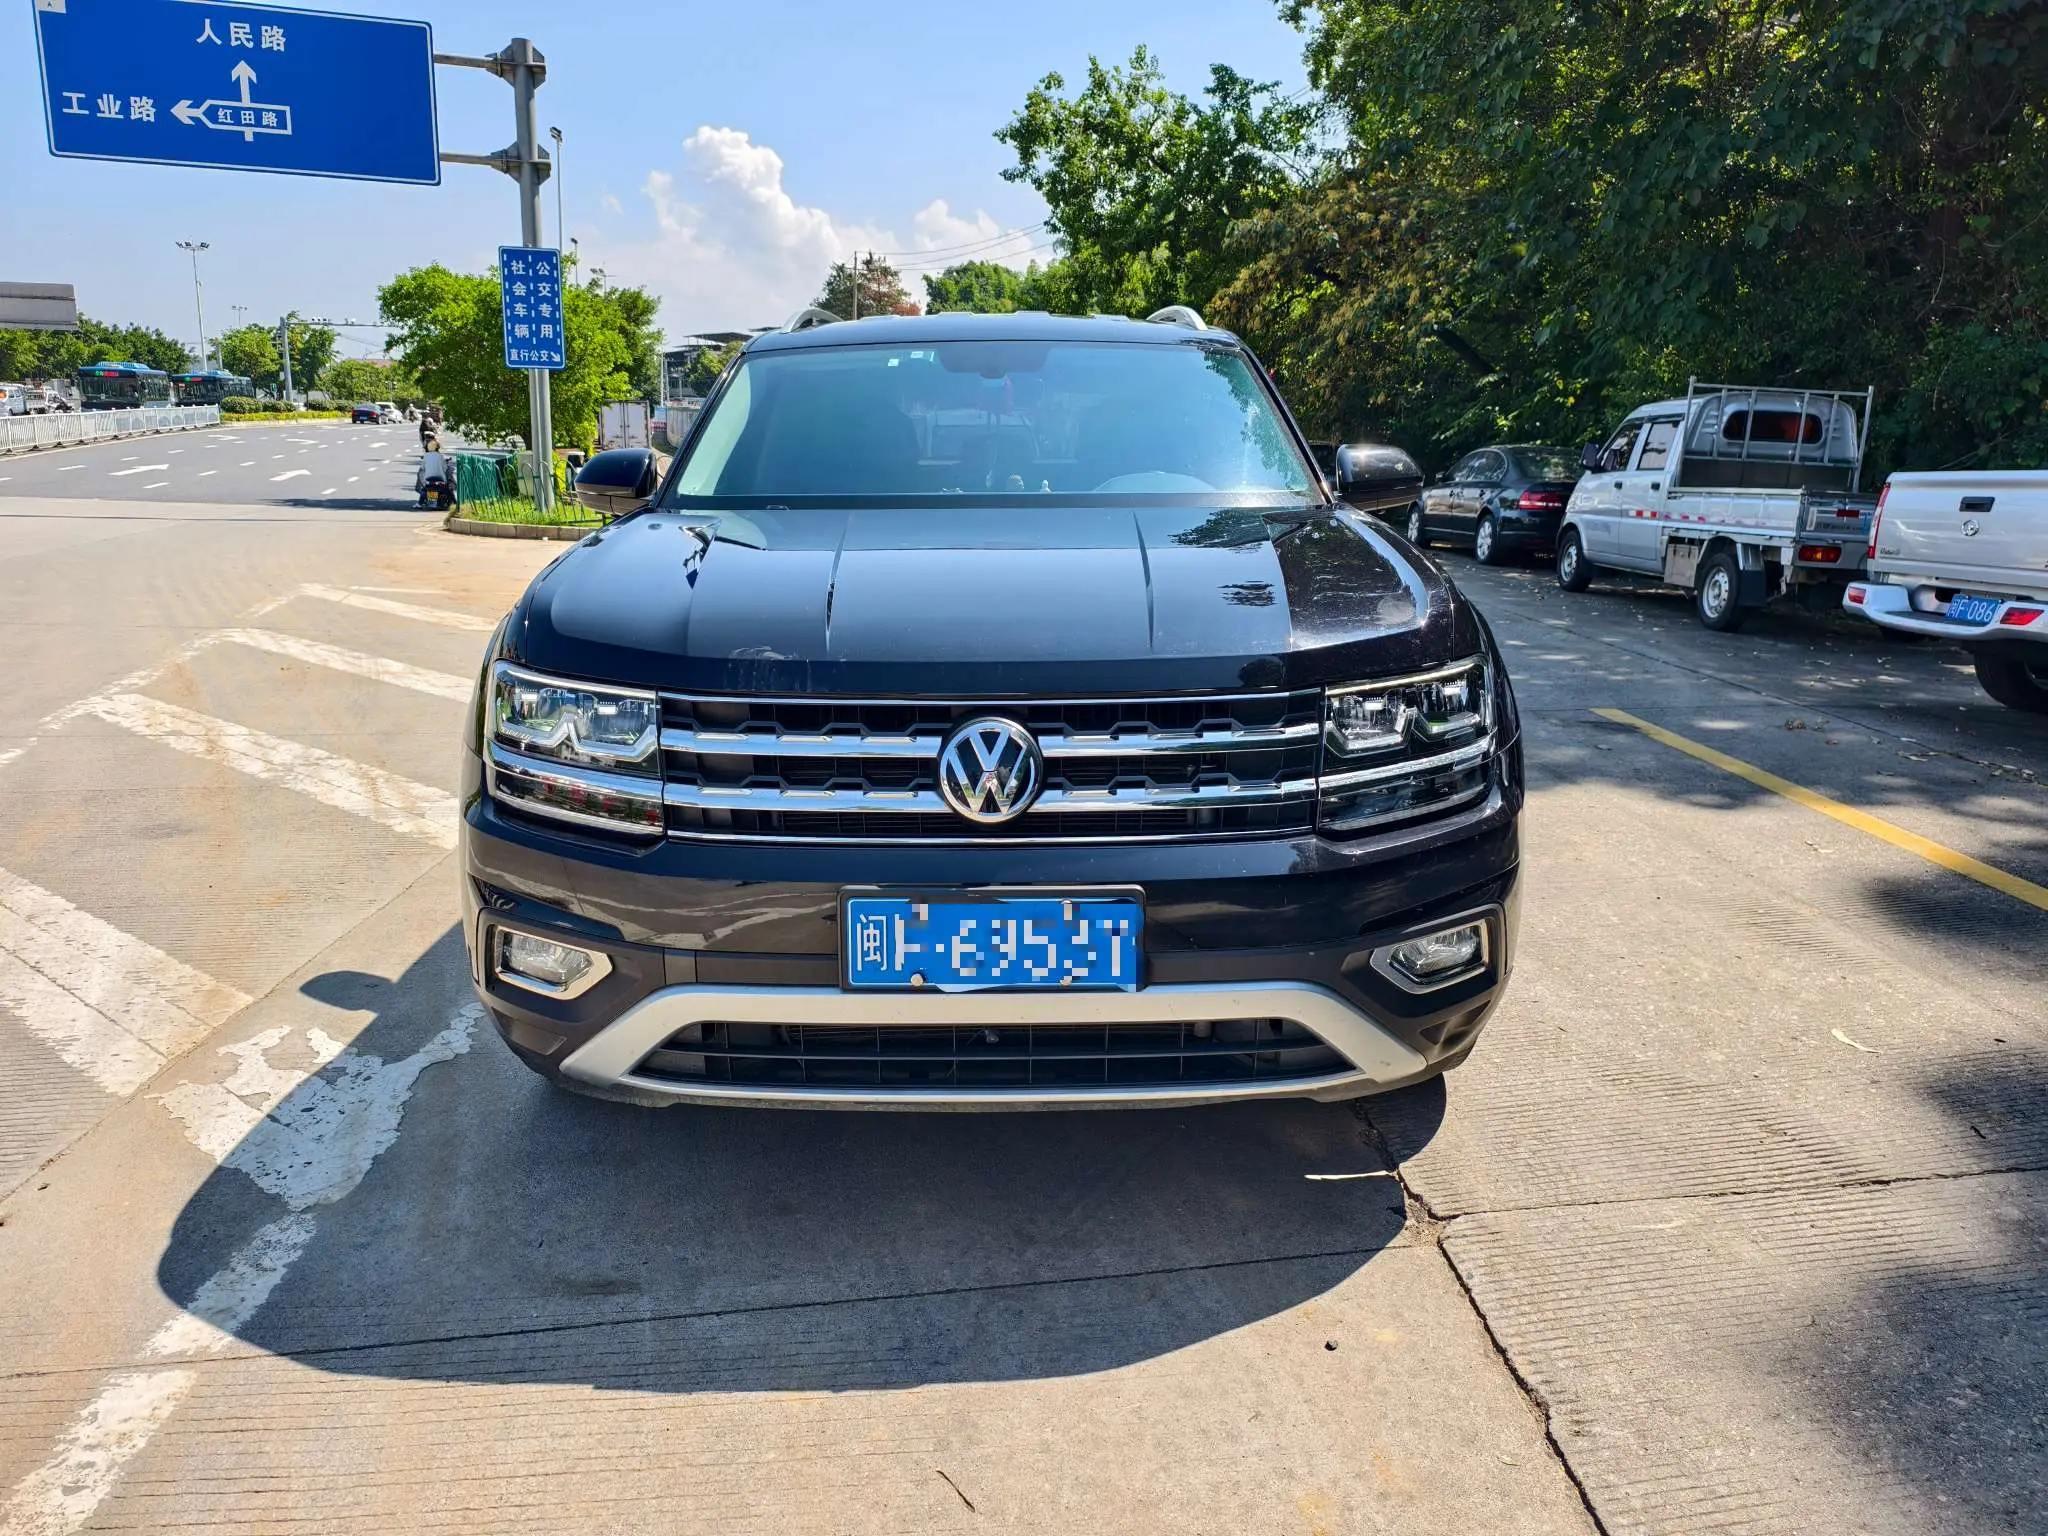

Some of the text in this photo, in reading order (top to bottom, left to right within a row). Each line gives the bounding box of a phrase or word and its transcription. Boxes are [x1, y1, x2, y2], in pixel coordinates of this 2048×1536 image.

[196, 18, 286, 52] 人民路
[62, 91, 157, 122] 工业路
[217, 108, 278, 127] 红田路
[510, 260, 530, 338] 社会车辆
[536, 261, 554, 339] 公交专用
[509, 349, 550, 362] 直行公交
